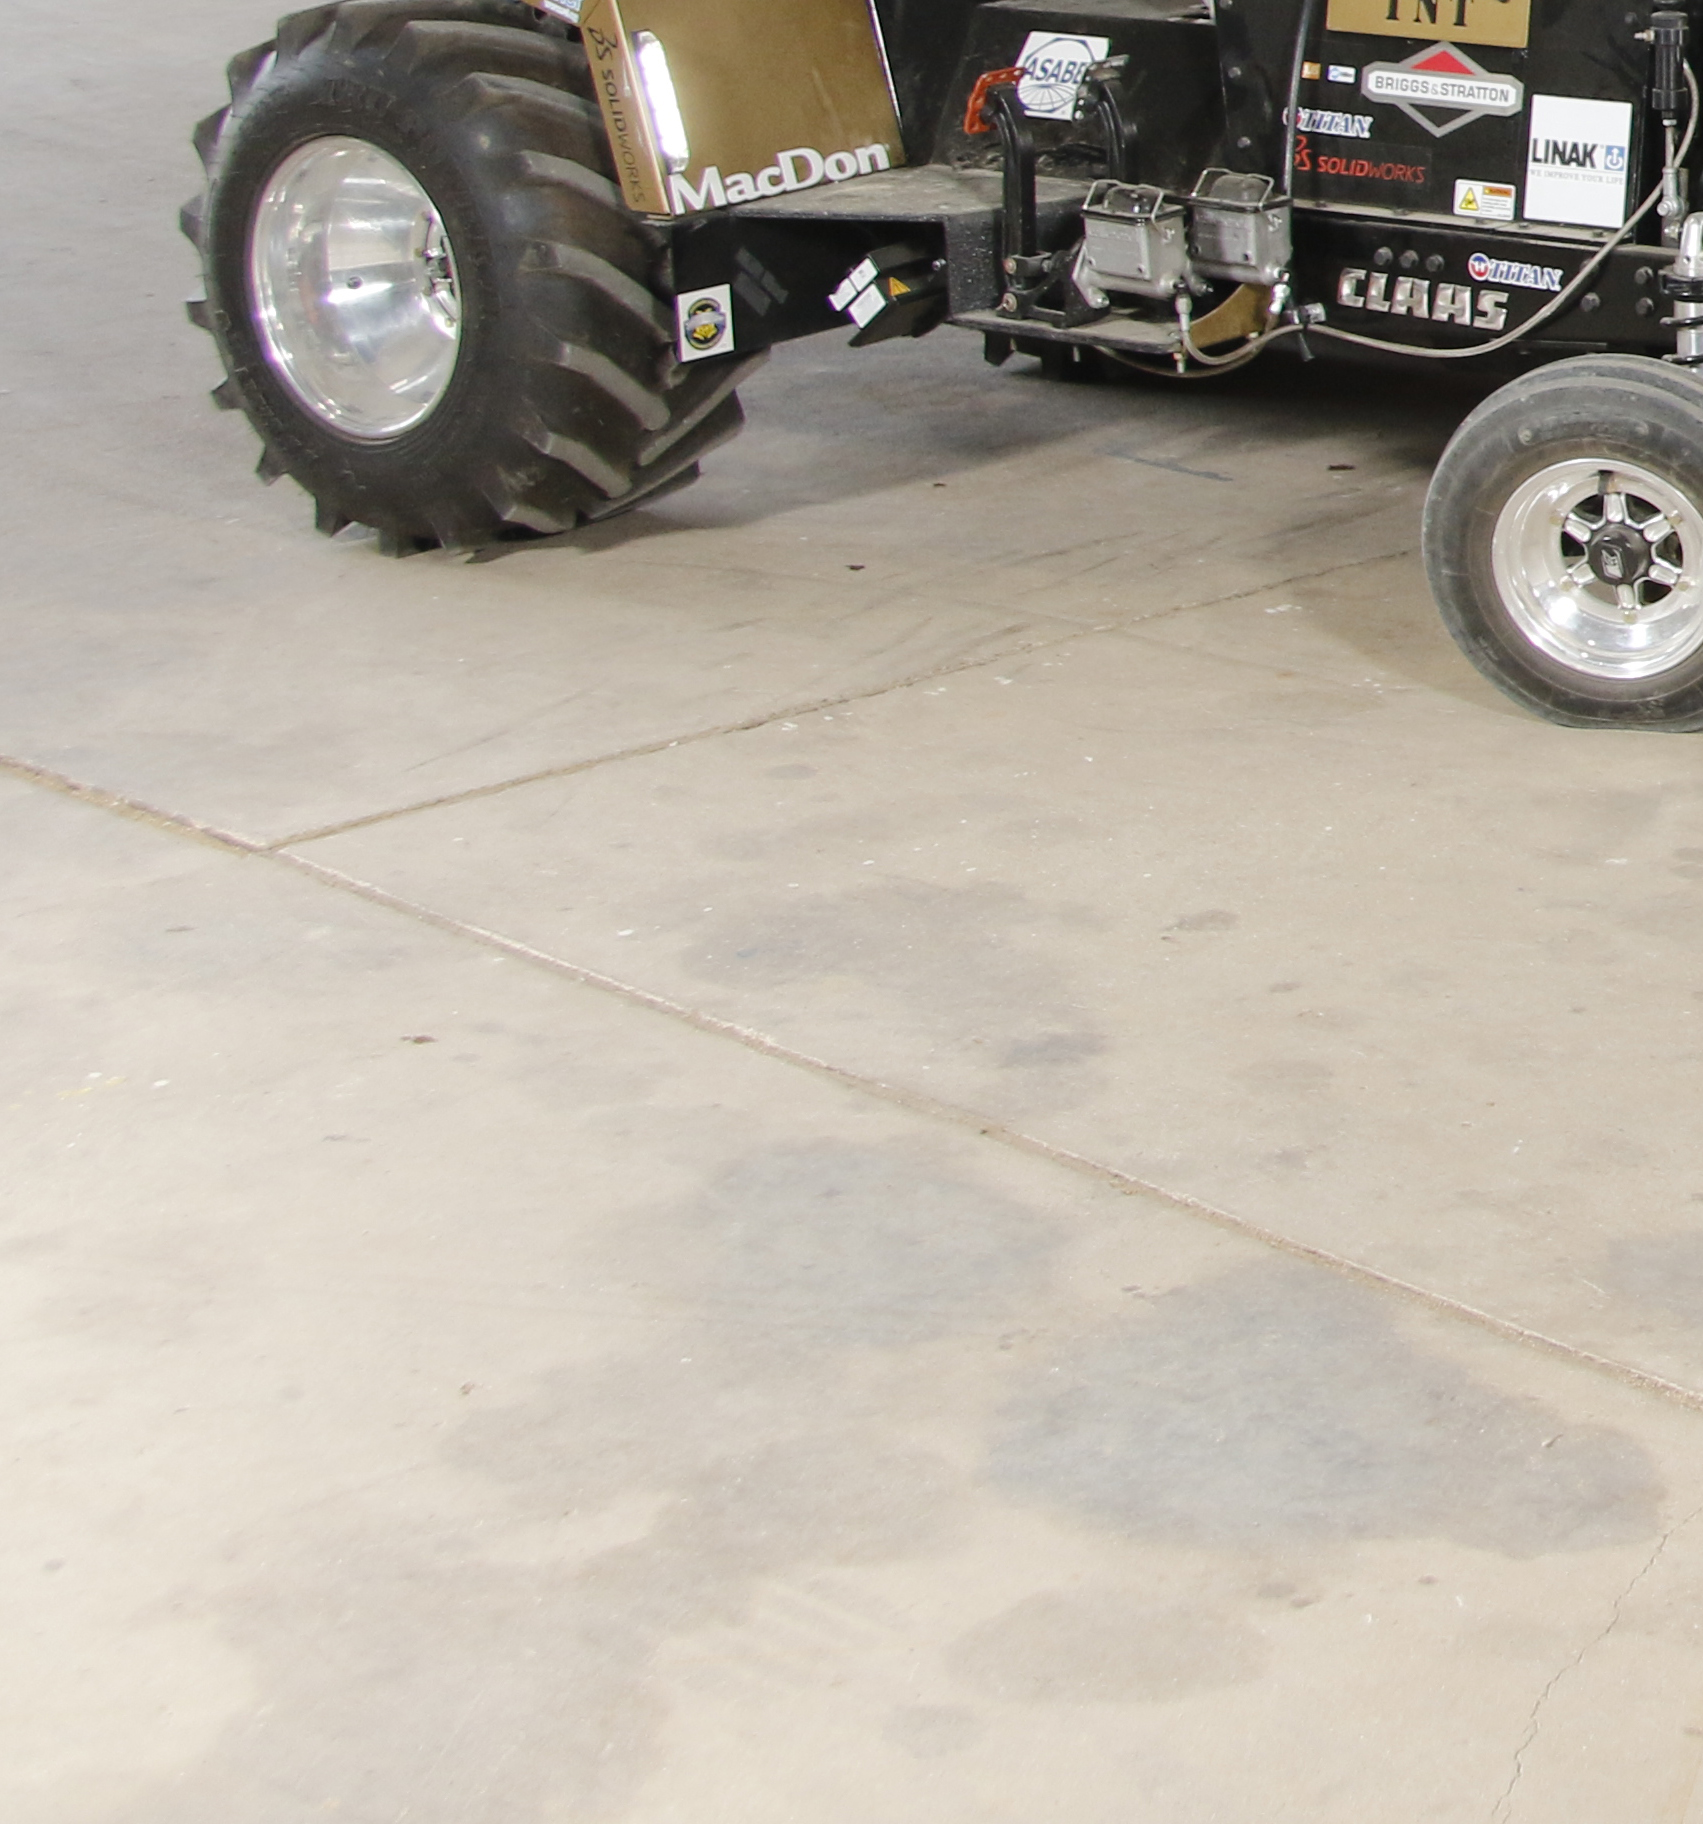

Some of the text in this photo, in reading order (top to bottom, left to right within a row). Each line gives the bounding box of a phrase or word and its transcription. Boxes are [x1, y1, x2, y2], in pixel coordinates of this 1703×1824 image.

[601, 69, 648, 205] SOLIDWORKS
[1302, 110, 1373, 137] TITAN
[1317, 155, 1425, 183] SOLIDWORKS
[1531, 138, 1598, 168] LINAK
[670, 143, 891, 216] MacDon
[1489, 259, 1563, 291] TITAN
[1337, 267, 1509, 331] CLAAS
